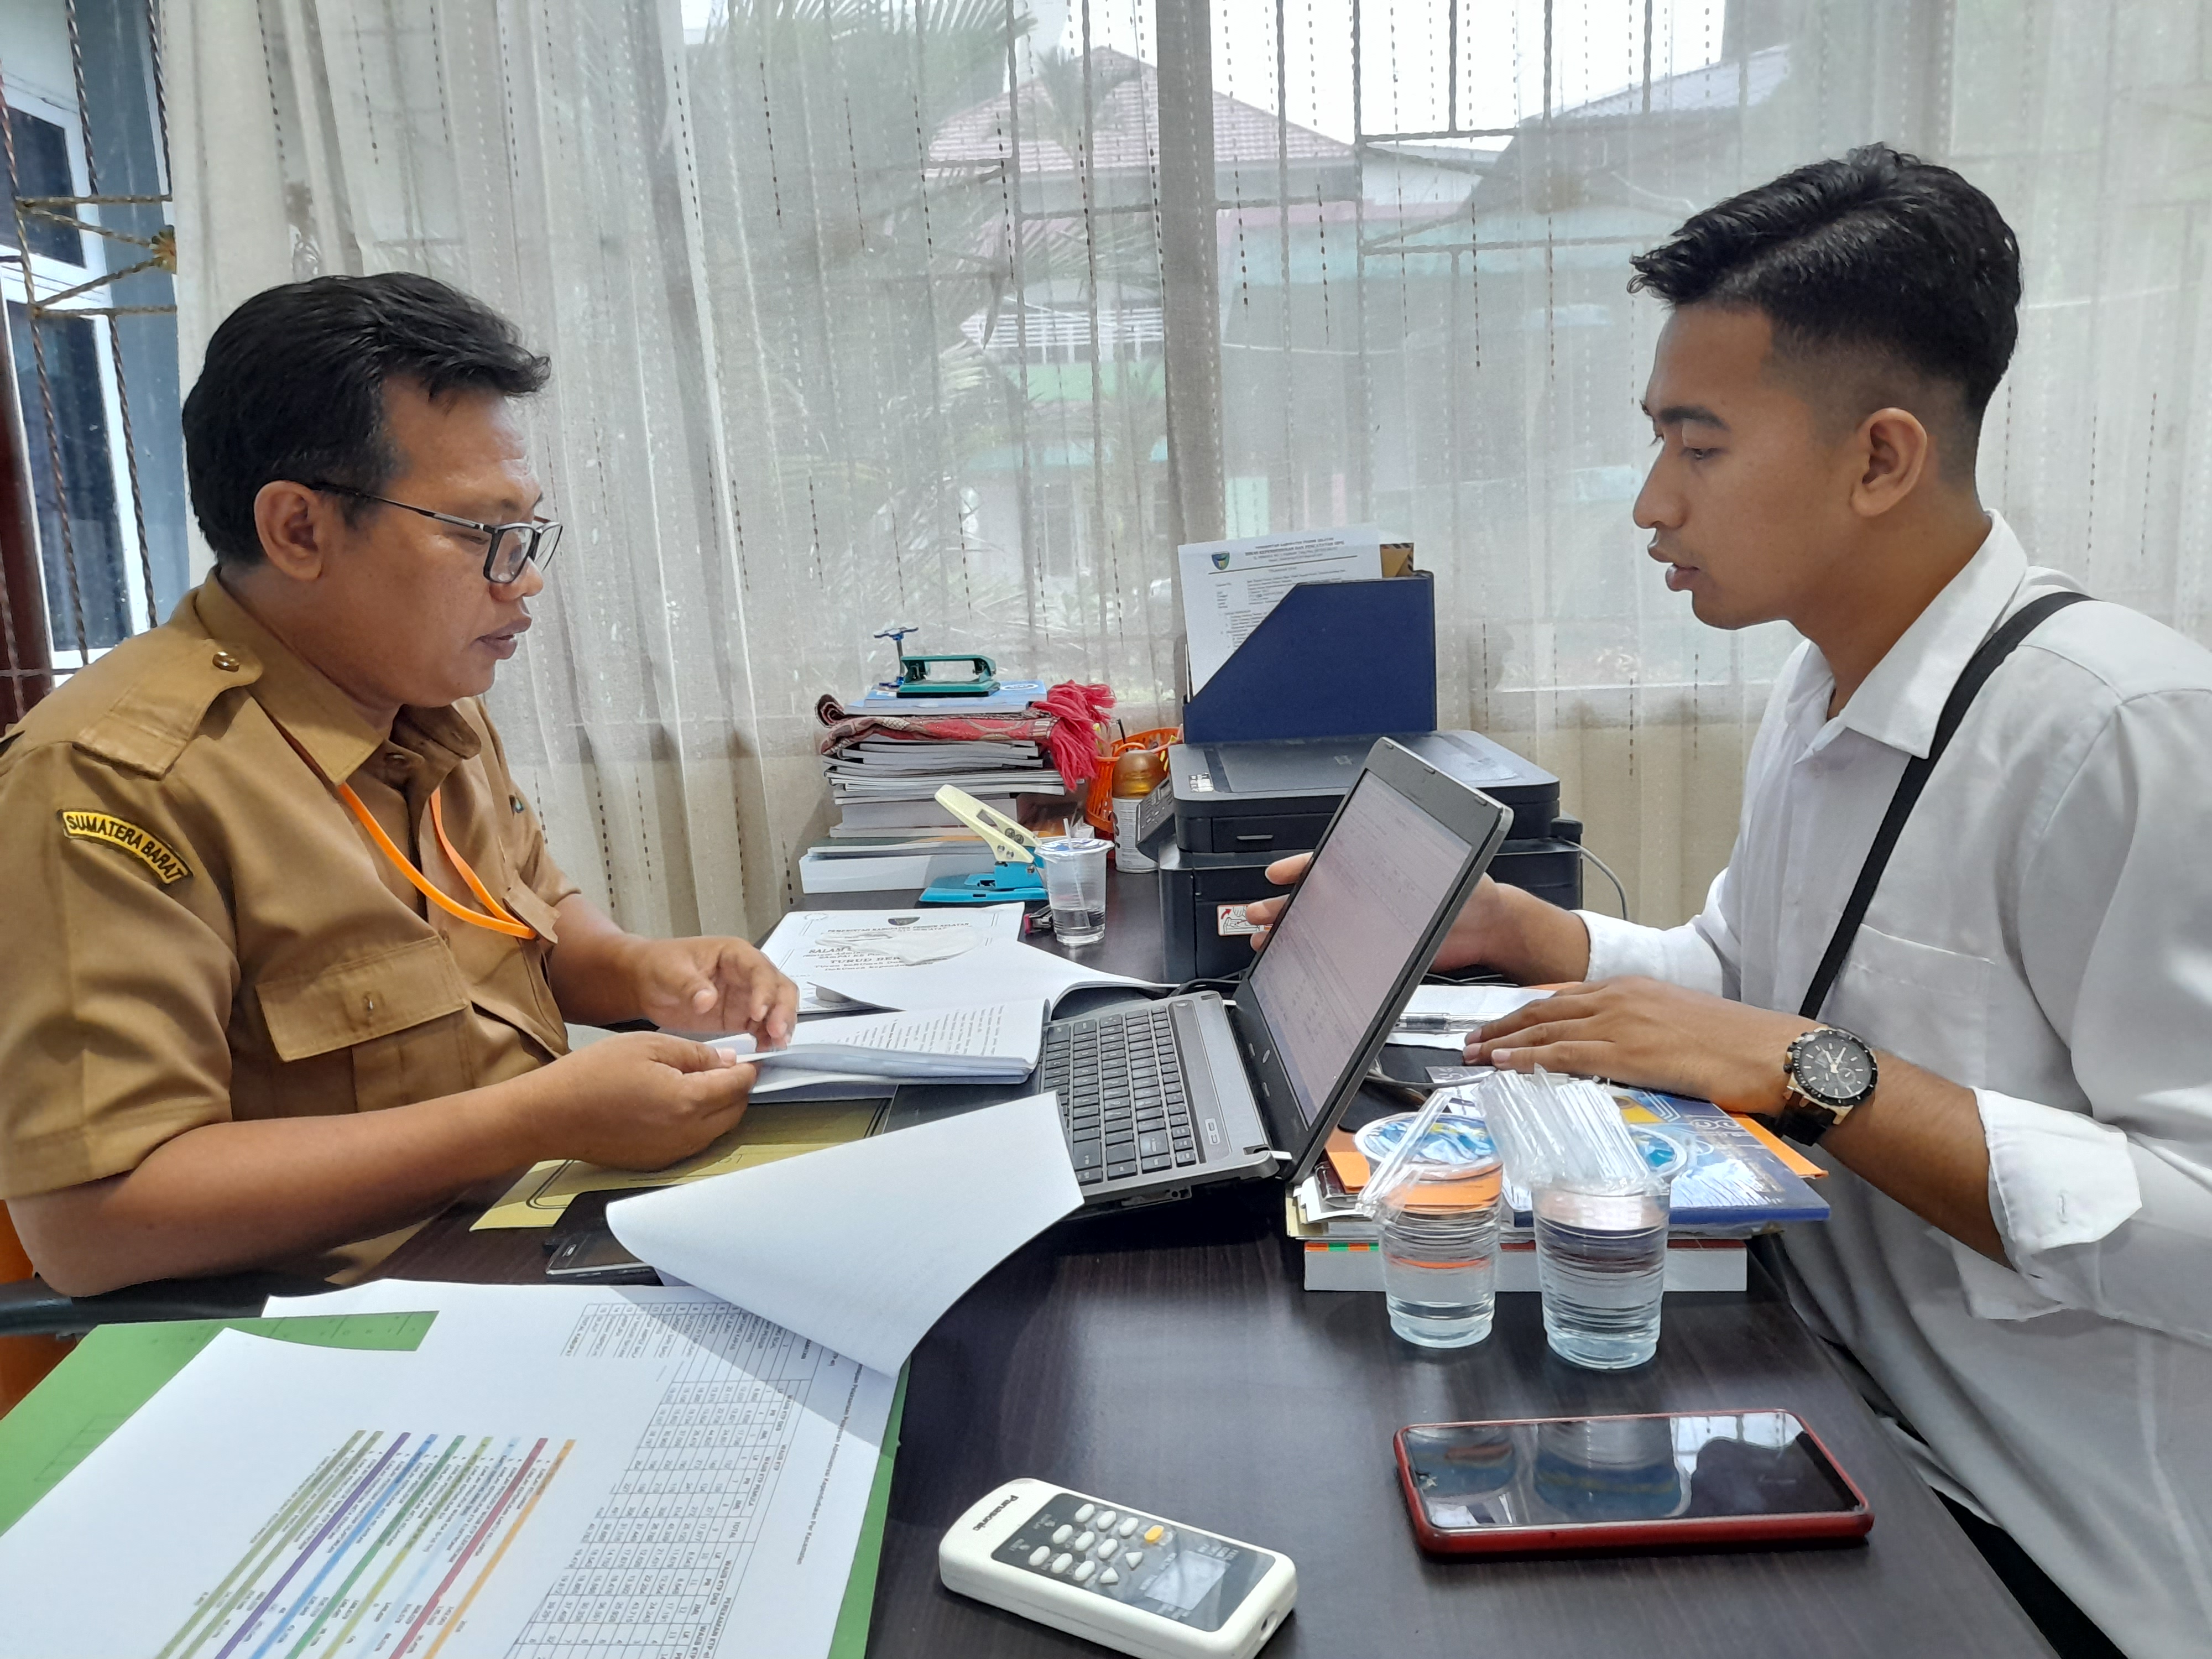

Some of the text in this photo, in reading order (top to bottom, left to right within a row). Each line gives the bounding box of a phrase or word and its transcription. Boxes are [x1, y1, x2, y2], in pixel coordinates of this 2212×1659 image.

[66, 815, 184, 880] SUMATERA BARAT
[728, 1521, 742, 1538] TOTAL
[973, 1494, 1019, 1532] Panasonic
